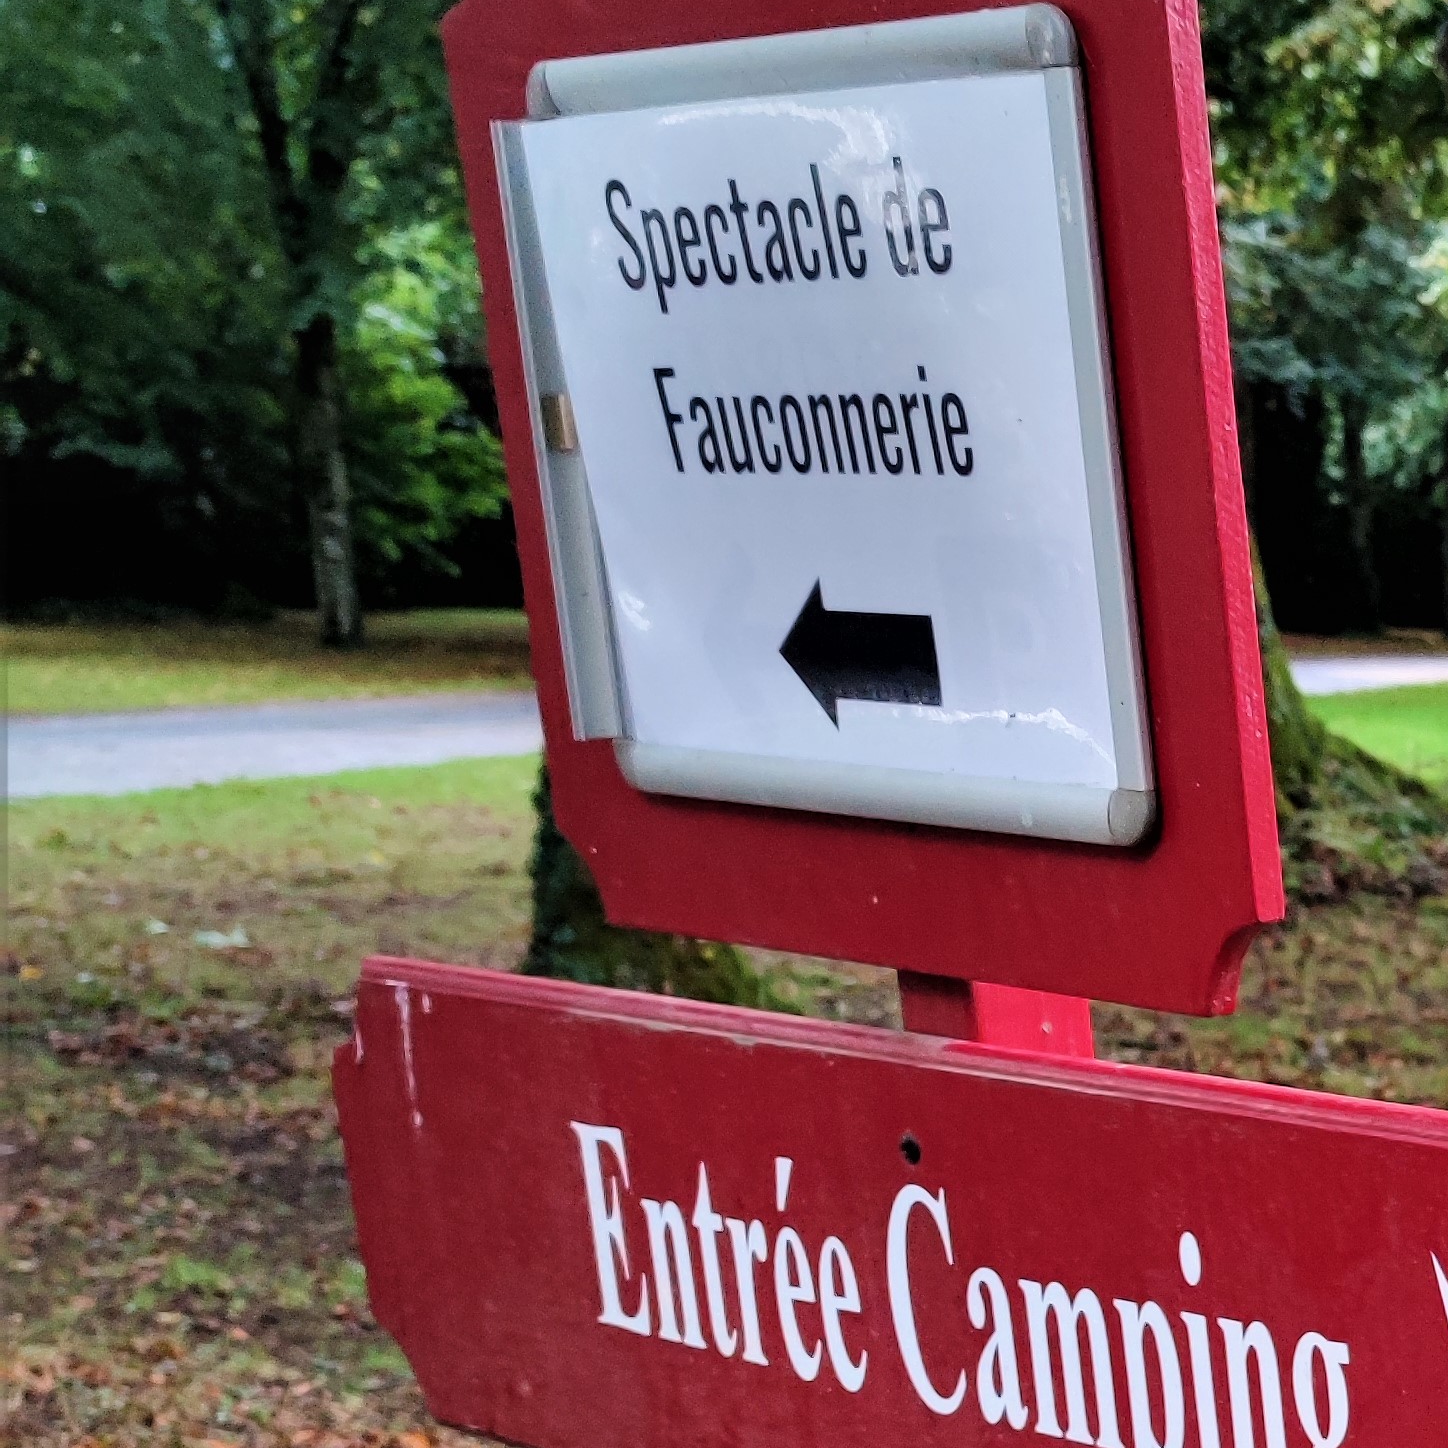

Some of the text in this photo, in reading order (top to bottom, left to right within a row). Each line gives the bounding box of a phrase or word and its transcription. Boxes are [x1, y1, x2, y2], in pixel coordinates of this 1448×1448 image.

[605, 156, 953, 314] Spectacle de
[653, 365, 974, 476] Fauconnerie
[569, 1121, 867, 1392] Entrée
